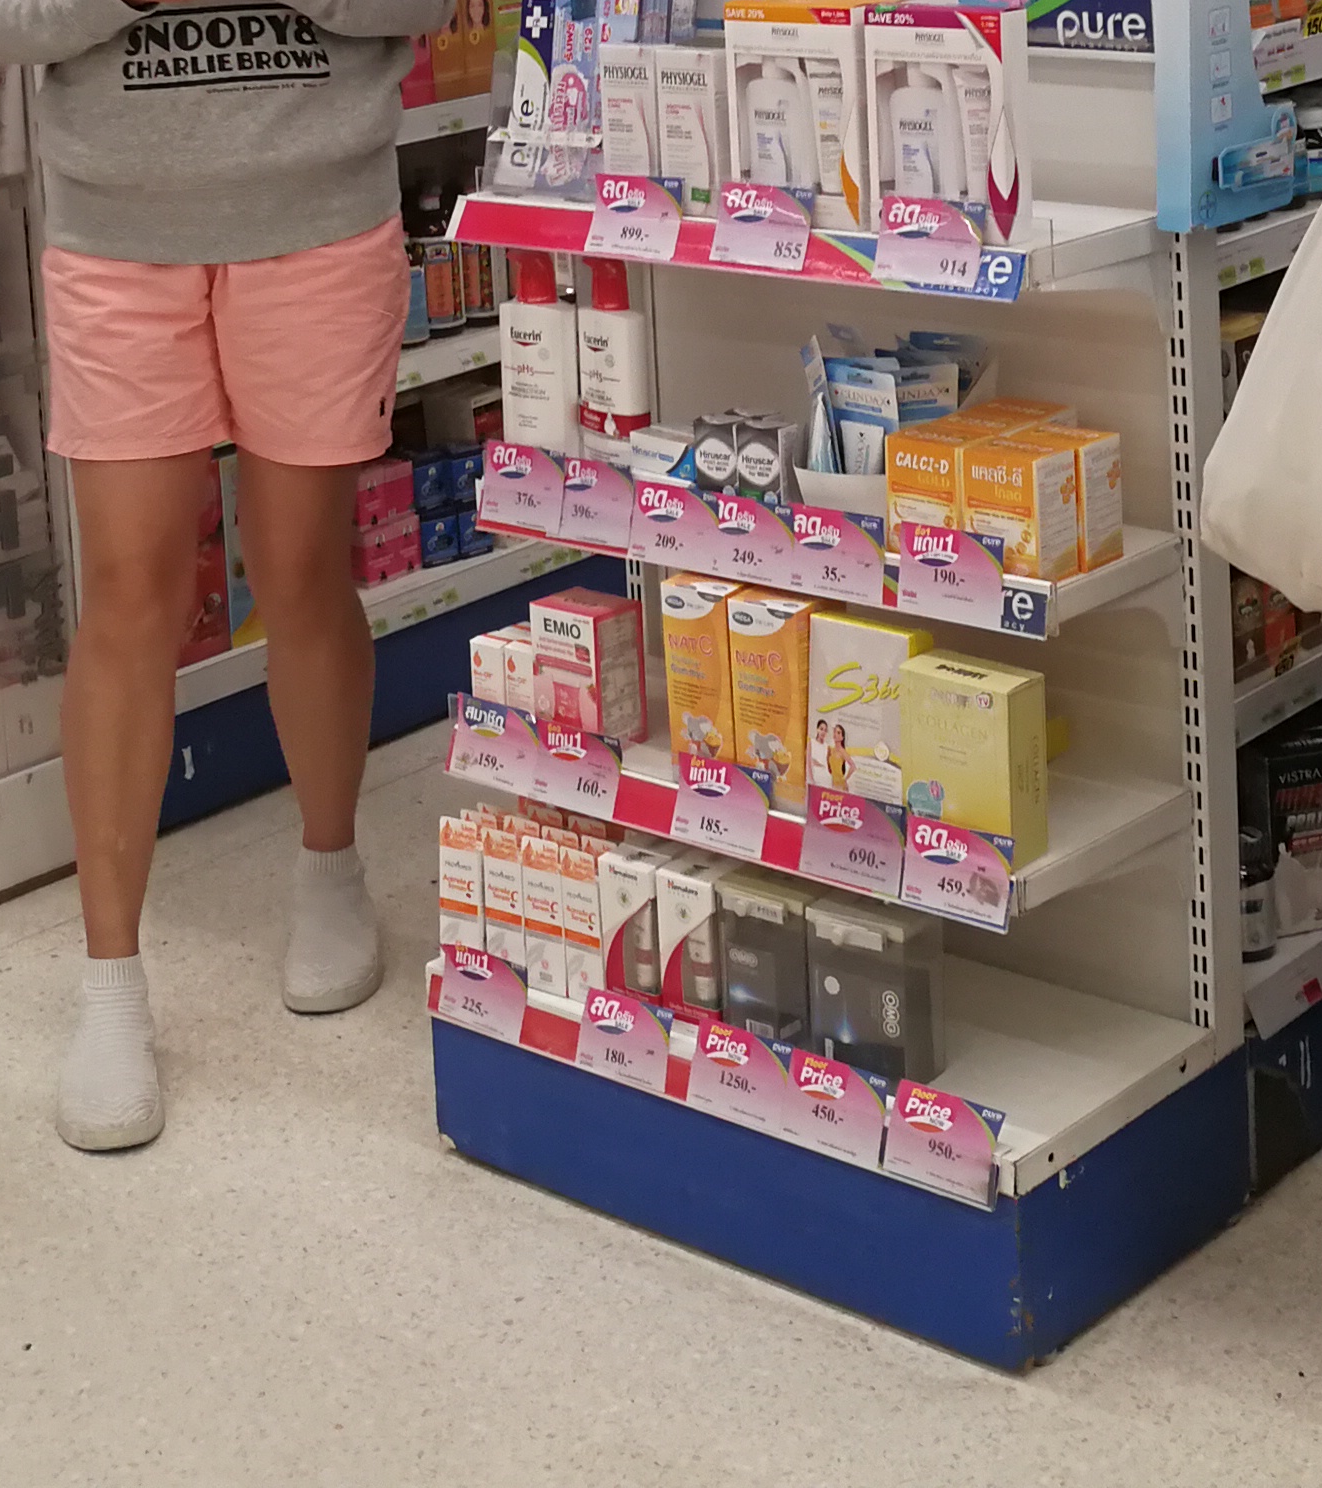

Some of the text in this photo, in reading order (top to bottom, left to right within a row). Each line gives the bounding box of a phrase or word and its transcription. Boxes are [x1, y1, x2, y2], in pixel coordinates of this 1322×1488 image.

[724, 7, 747, 20] SAVE
[867, 11, 915, 25] SAVE 20%
[1055, 10, 1147, 42] pure
[122, 48, 330, 80] CHARLIE BROWN
[603, 65, 708, 88] PHYSIOGEL PHYSIOGEL
[775, 241, 803, 260] 855
[938, 258, 968, 277] 914
[509, 326, 611, 347] Eucerin Eucerin
[895, 451, 950, 473] CALCI-D
[543, 617, 582, 639] EMIO
[1277, 767, 1322, 784] VISTRA
[818, 800, 861, 819] Price
[882, 990, 901, 1038] OMG
[710, 1025, 734, 1037] Floor
[705, 1035, 747, 1055] Price
[805, 1057, 829, 1070] Floor
[800, 1066, 843, 1088] Price
[911, 1087, 937, 1101] Floor
[905, 1097, 952, 1121] Price
